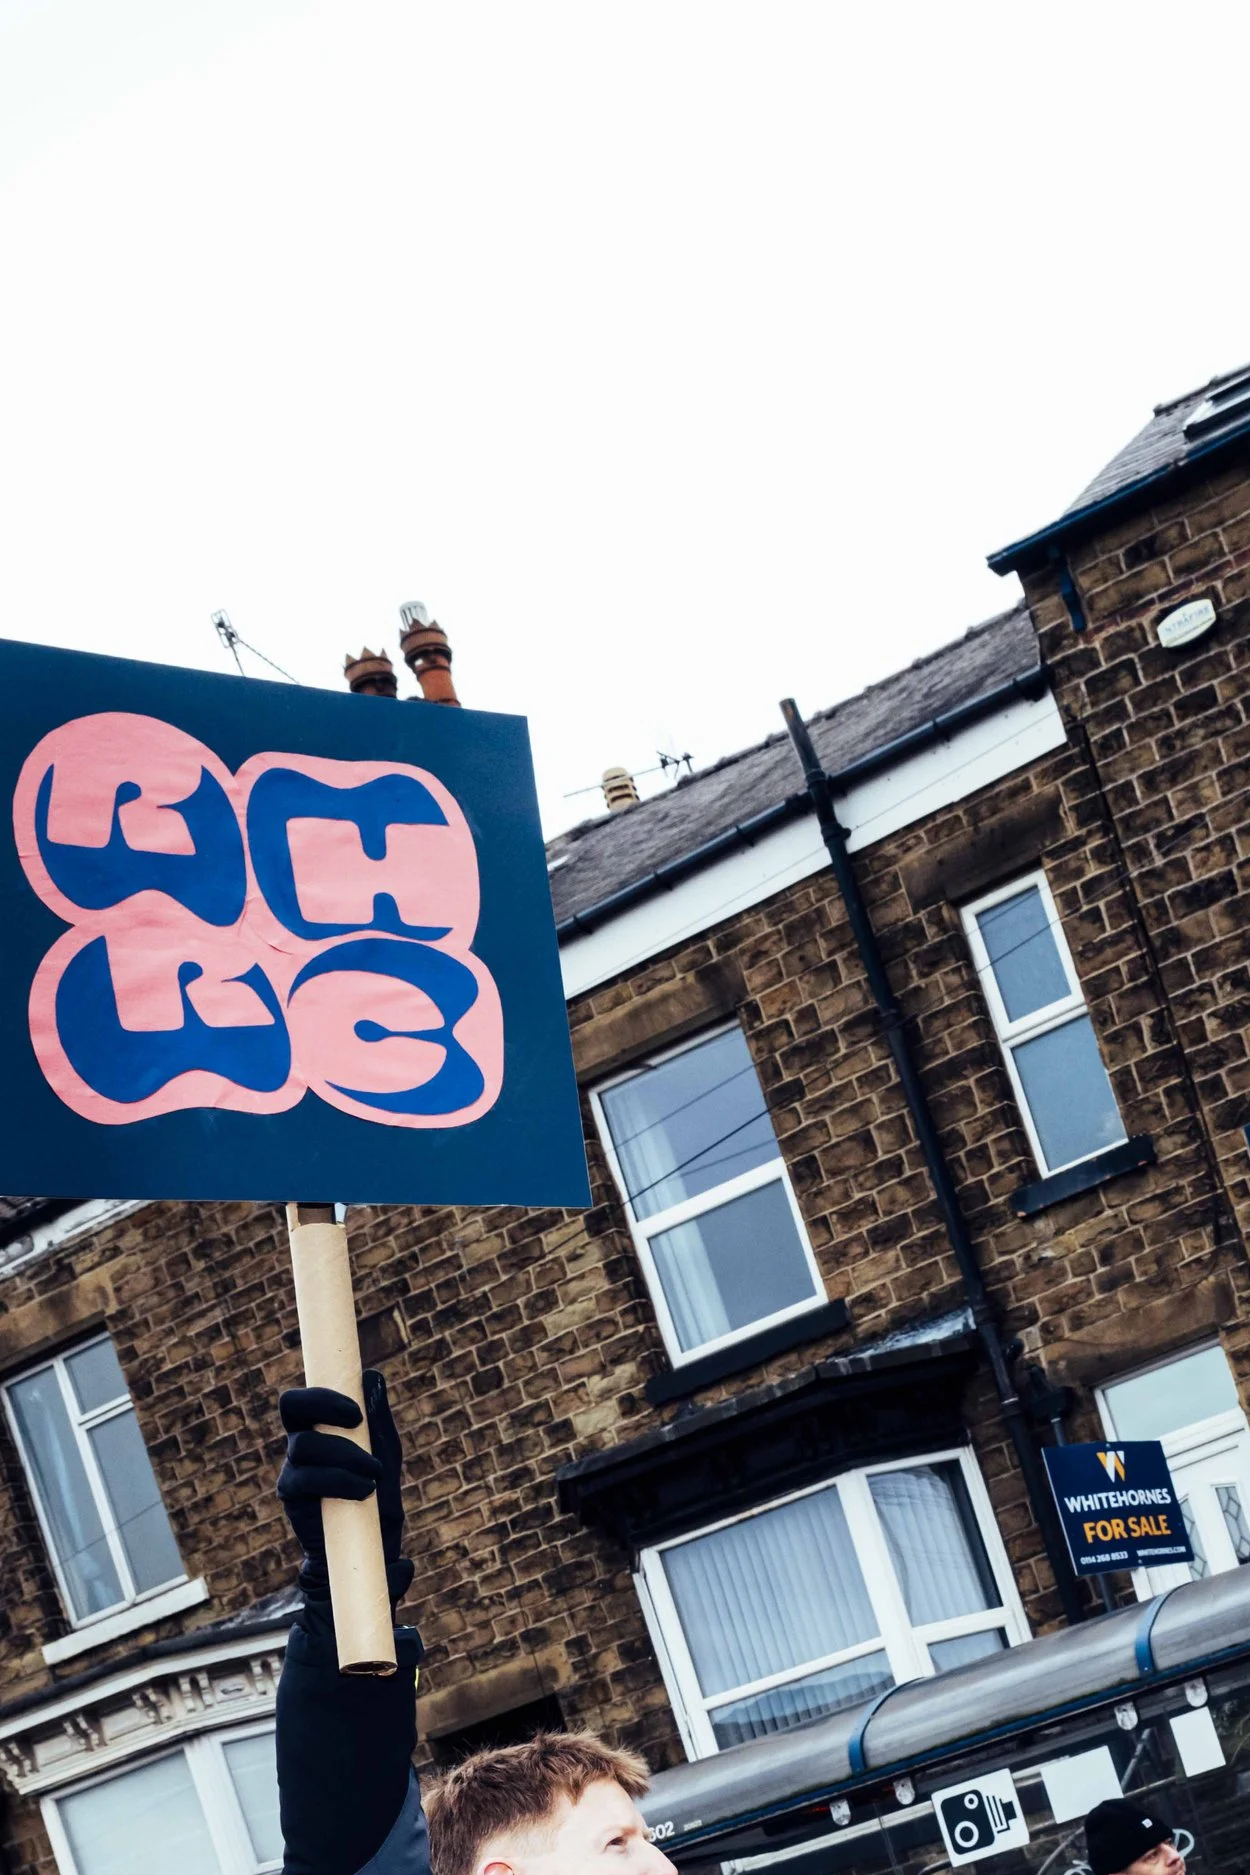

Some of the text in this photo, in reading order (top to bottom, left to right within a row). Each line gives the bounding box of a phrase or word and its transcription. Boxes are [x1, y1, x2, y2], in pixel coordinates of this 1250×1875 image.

[1064, 1488, 1172, 1514] WHITEHORNES
[1083, 1515, 1172, 1544] FOR SALE
